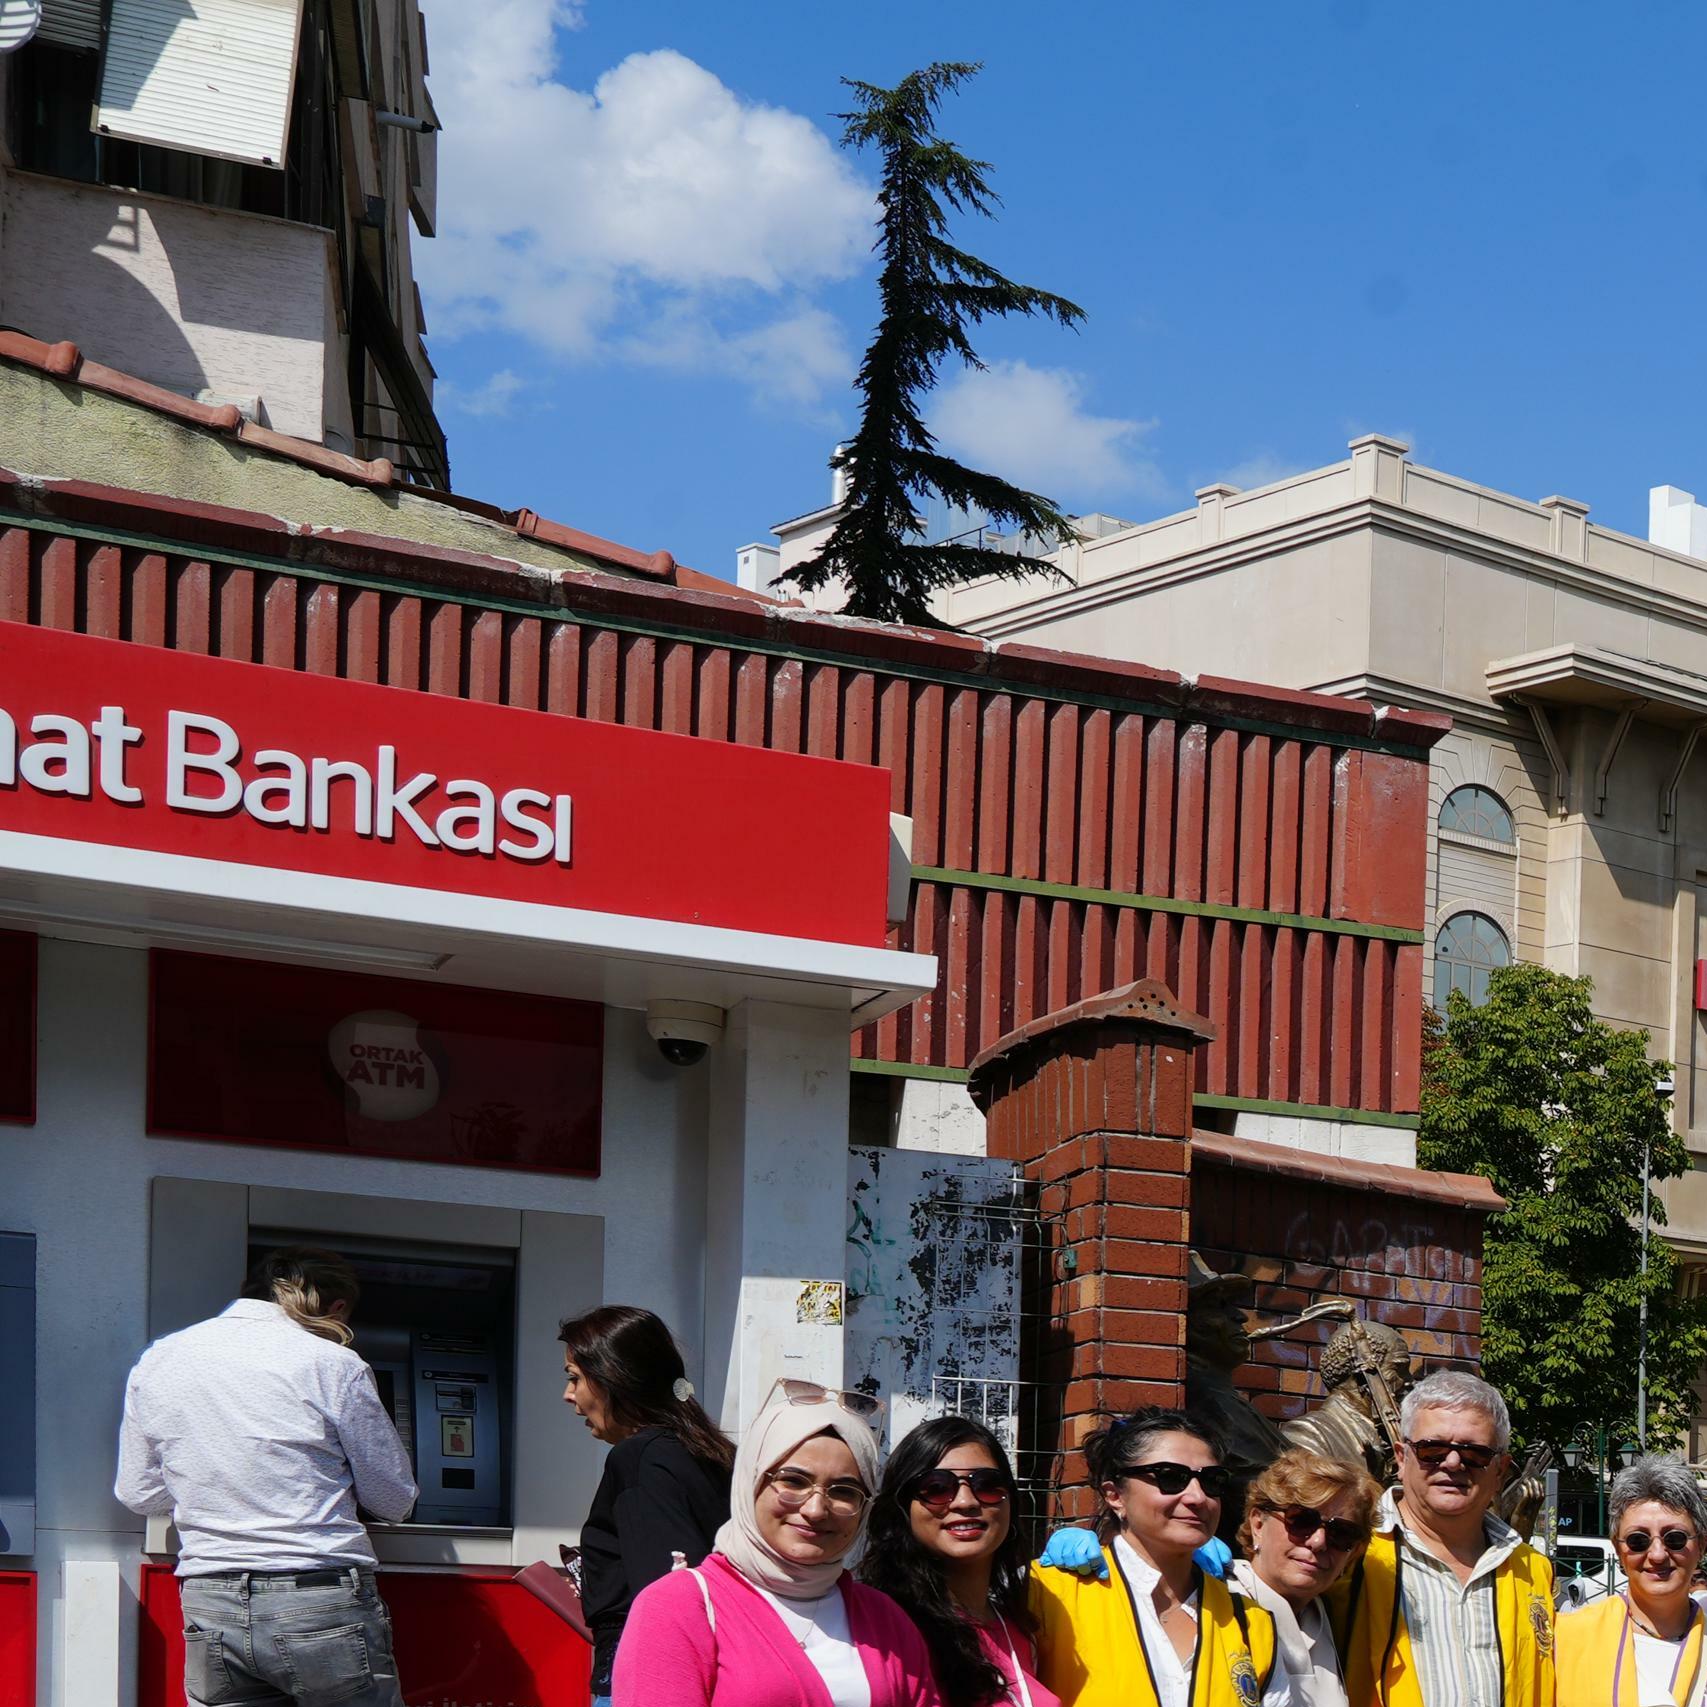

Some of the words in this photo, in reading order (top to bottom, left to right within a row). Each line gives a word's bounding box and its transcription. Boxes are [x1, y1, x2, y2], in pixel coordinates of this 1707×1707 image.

[166, 709, 573, 866] Bankası
[349, 1043, 424, 1065] ORTAK
[346, 1059, 425, 1090] ATM
